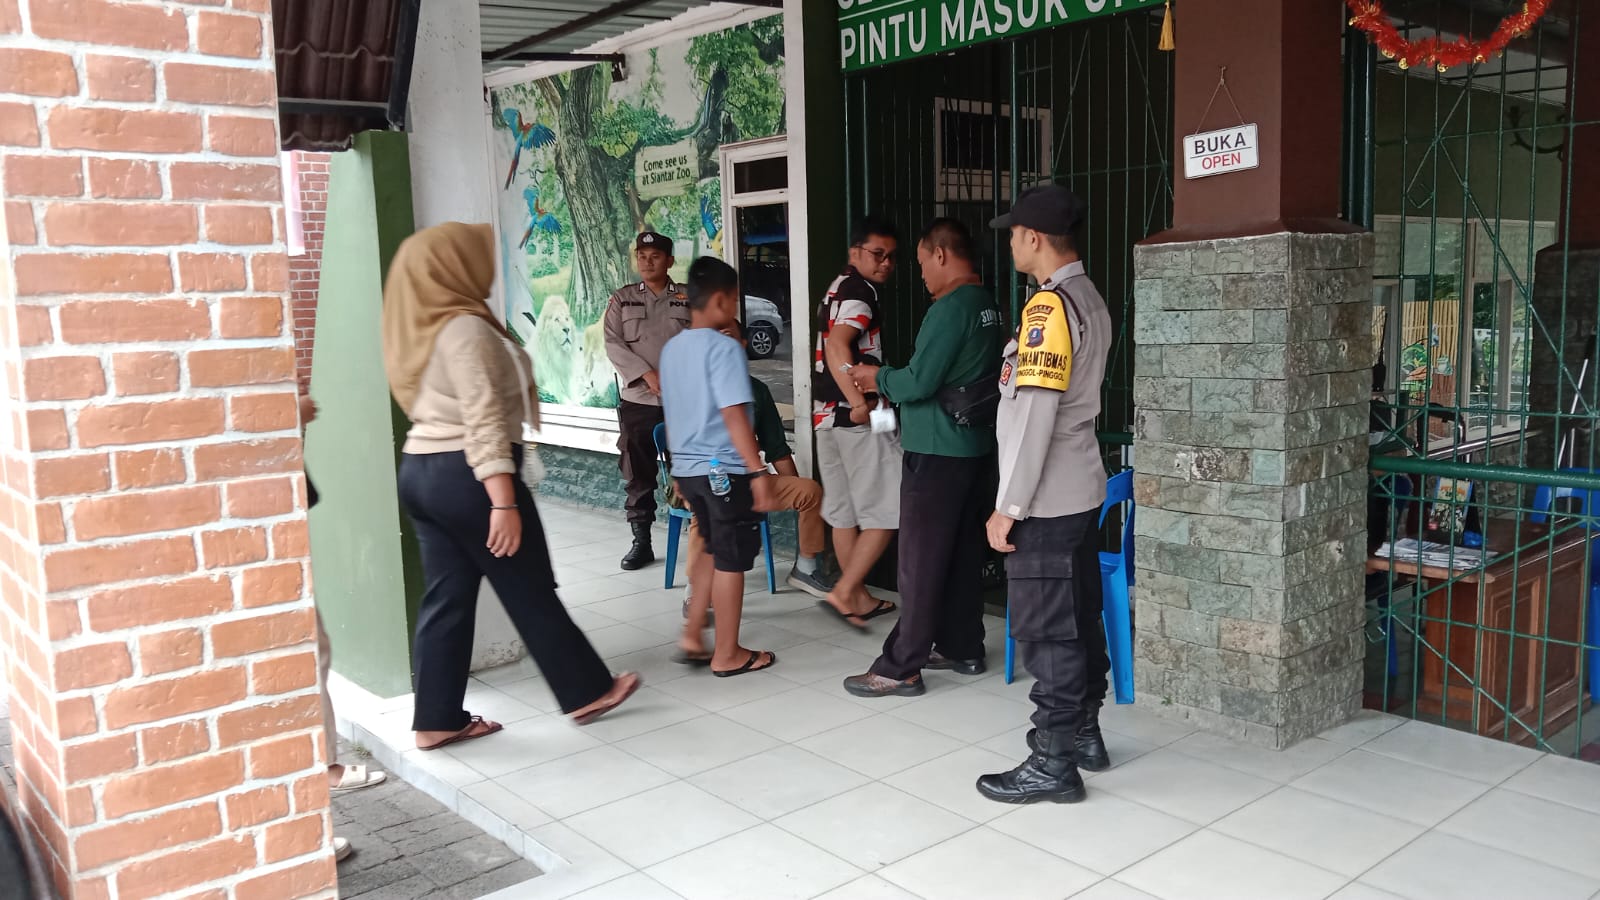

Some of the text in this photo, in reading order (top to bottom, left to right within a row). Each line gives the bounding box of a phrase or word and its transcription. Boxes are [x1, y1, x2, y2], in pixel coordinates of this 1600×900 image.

[840, 7, 927, 69] PINTU
[1195, 132, 1246, 154] BUKA
[643, 155, 688, 172] Come see us
[1202, 152, 1241, 170] OPEN
[642, 167, 691, 186] at Siantar Zoo
